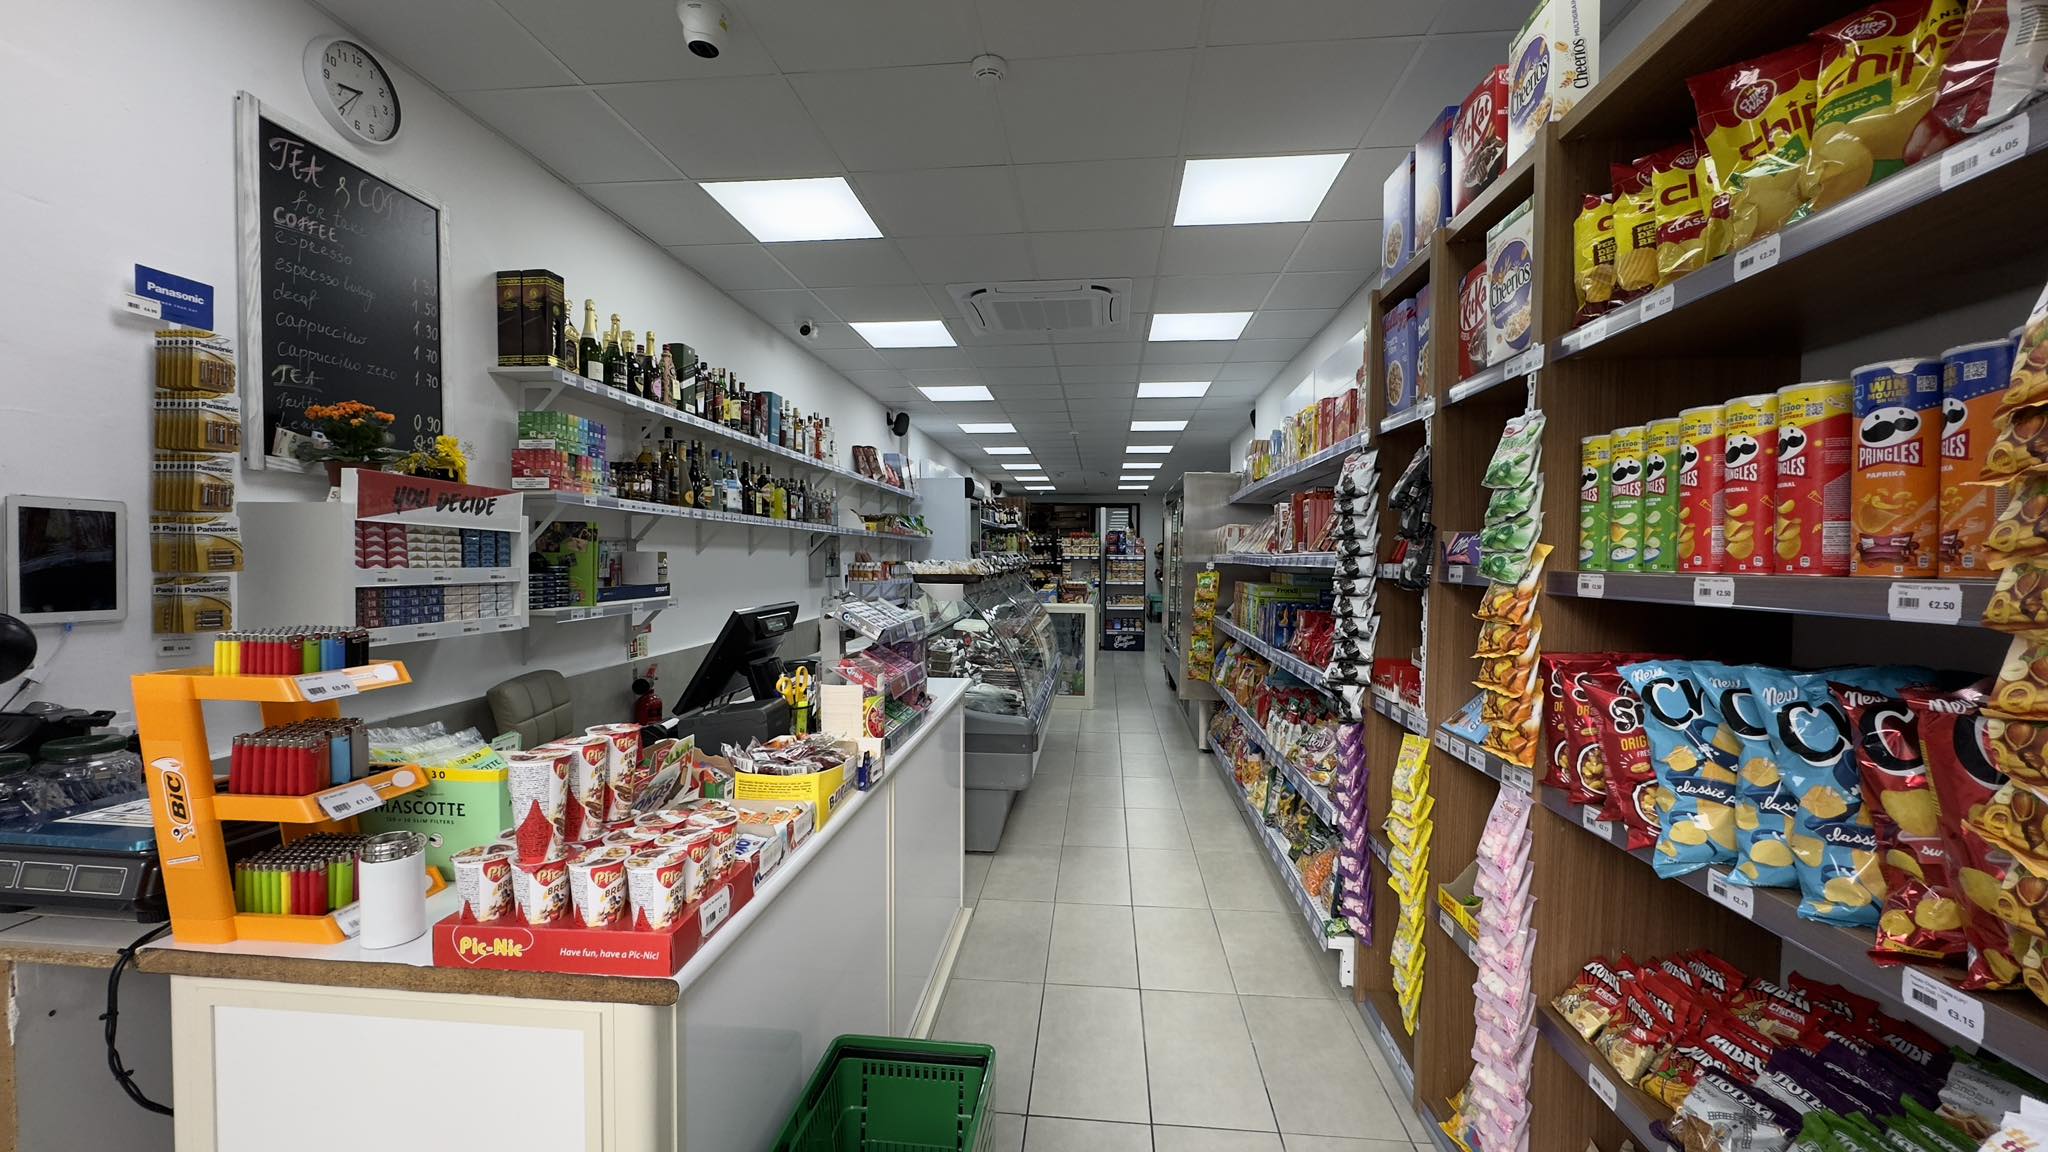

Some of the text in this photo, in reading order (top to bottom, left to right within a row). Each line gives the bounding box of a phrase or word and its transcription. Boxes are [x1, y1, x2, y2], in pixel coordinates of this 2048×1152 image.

[1844, 20, 1888, 36] CHIPS
[1847, 28, 1881, 38] WAY
[326, 53, 336, 67] 10
[337, 49, 347, 62] 11
[352, 54, 362, 68] 12
[1573, 38, 1590, 89] Cheerios
[324, 69, 330, 80] 9
[379, 87, 385, 98] 2
[1512, 55, 1549, 119] Cheerios
[355, 120, 361, 131] 6
[369, 124, 375, 135] 5
[1989, 138, 2019, 158] €4.05
[269, 137, 326, 189] TEA
[273, 207, 338, 242] COFFEE
[1759, 248, 1777, 260] €2.29
[147, 281, 205, 305] Panasonic
[1490, 262, 1532, 308] Cheerios
[1461, 276, 1488, 330] KitKa
[195, 340, 234, 354] Panasonic
[271, 364, 325, 386] TEA
[201, 401, 239, 413] Panasonic
[1942, 433, 1966, 458] GLES
[1859, 441, 1921, 468] PRINGLES
[196, 463, 233, 474] Panasonic
[1725, 463, 1758, 482] INGLES
[1777, 456, 1806, 477] NGLES
[1680, 470, 1698, 487] GLES
[1866, 470, 1906, 480] PAPRIKA
[1647, 477, 1665, 494] GLES
[393, 486, 498, 516] YOU DECIDE
[1582, 487, 1598, 502] GLES
[184, 585, 229, 593] Panasonic
[1716, 589, 1731, 597] €2.50
[1929, 601, 1955, 611] €2.50
[1631, 667, 1666, 683] New
[1709, 677, 1742, 689] New
[1762, 686, 1798, 706] New
[1845, 691, 1888, 707] New
[587, 749, 605, 763] Pic
[166, 774, 187, 820] BIC
[1676, 780, 1726, 800] classic
[374, 800, 466, 817] MASCOTTE
[691, 845, 710, 860] Pic
[660, 869, 681, 885] Pic
[547, 881, 567, 896] BRE
[459, 936, 523, 957] Pic-Nic
[560, 948, 580, 956] Have
[582, 948, 598, 958] fun,
[600, 950, 620, 958] have
[628, 951, 660, 960] Pic-Nic!
[1948, 1008, 1975, 1028] €3.15
